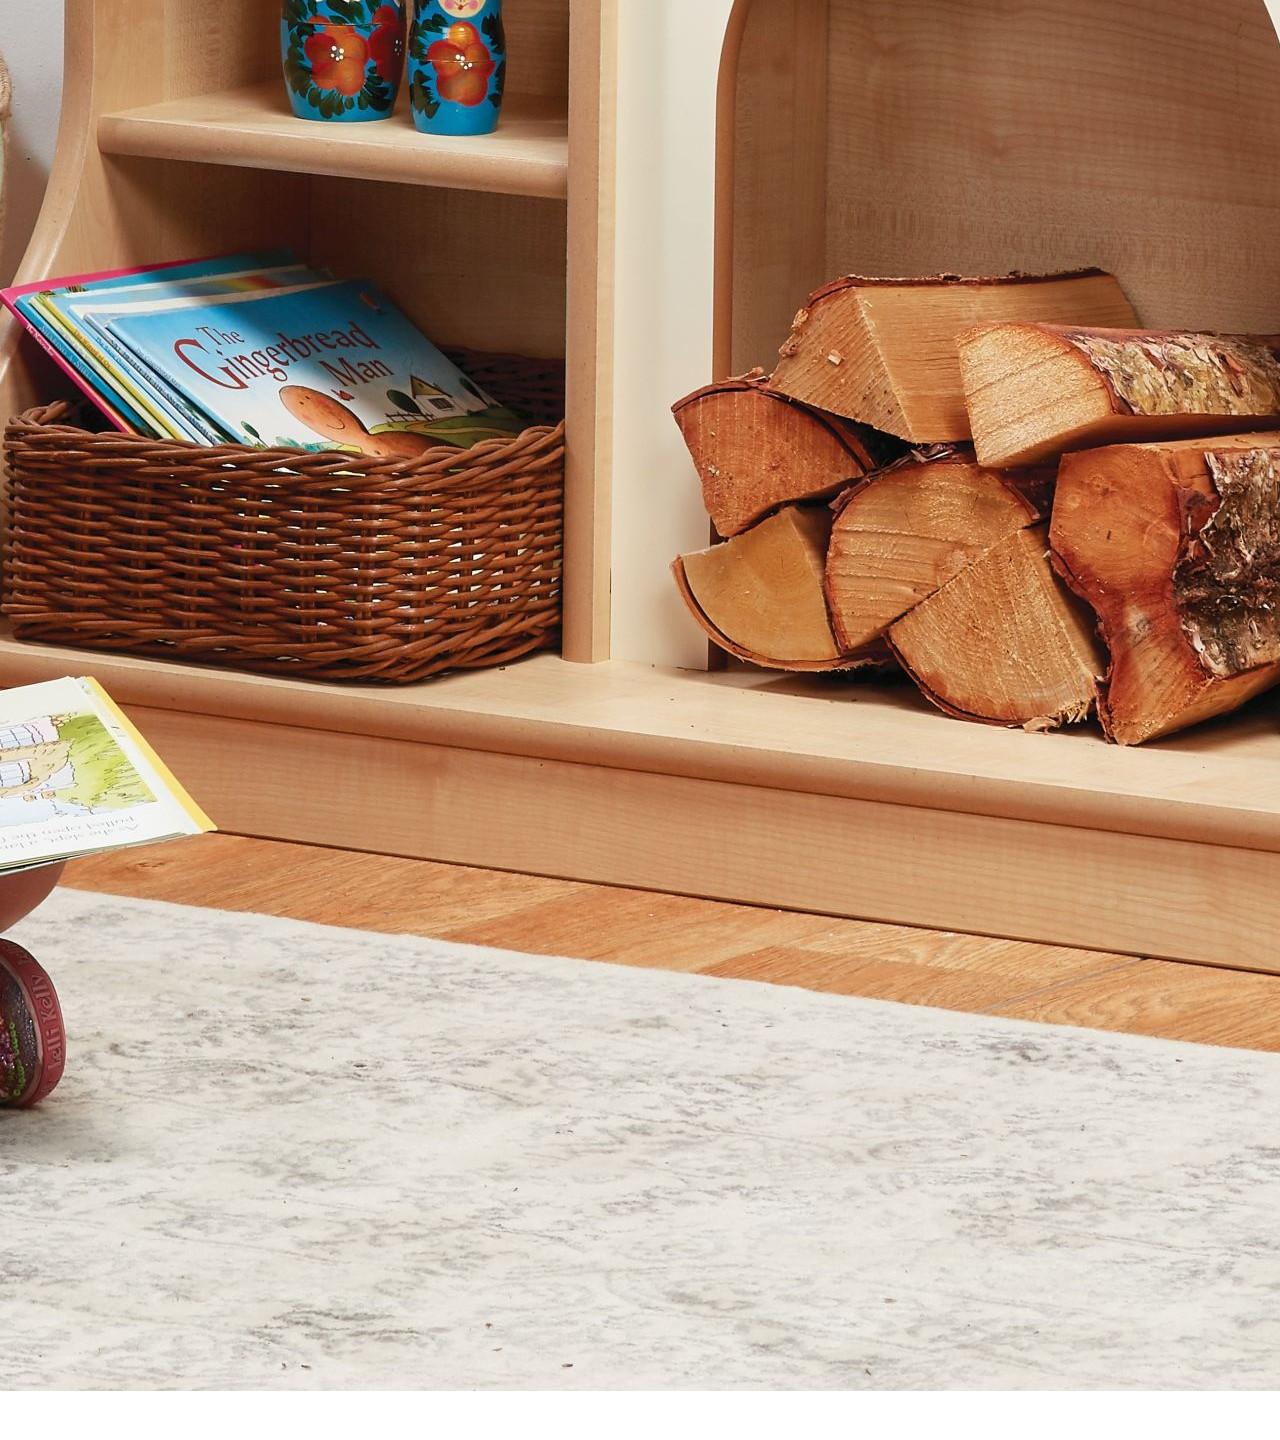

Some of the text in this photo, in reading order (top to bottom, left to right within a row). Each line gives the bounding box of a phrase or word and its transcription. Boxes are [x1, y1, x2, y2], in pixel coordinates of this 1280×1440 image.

[173, 320, 395, 390] The Gingerbread Man
[31, 975, 56, 1023] Kelly
